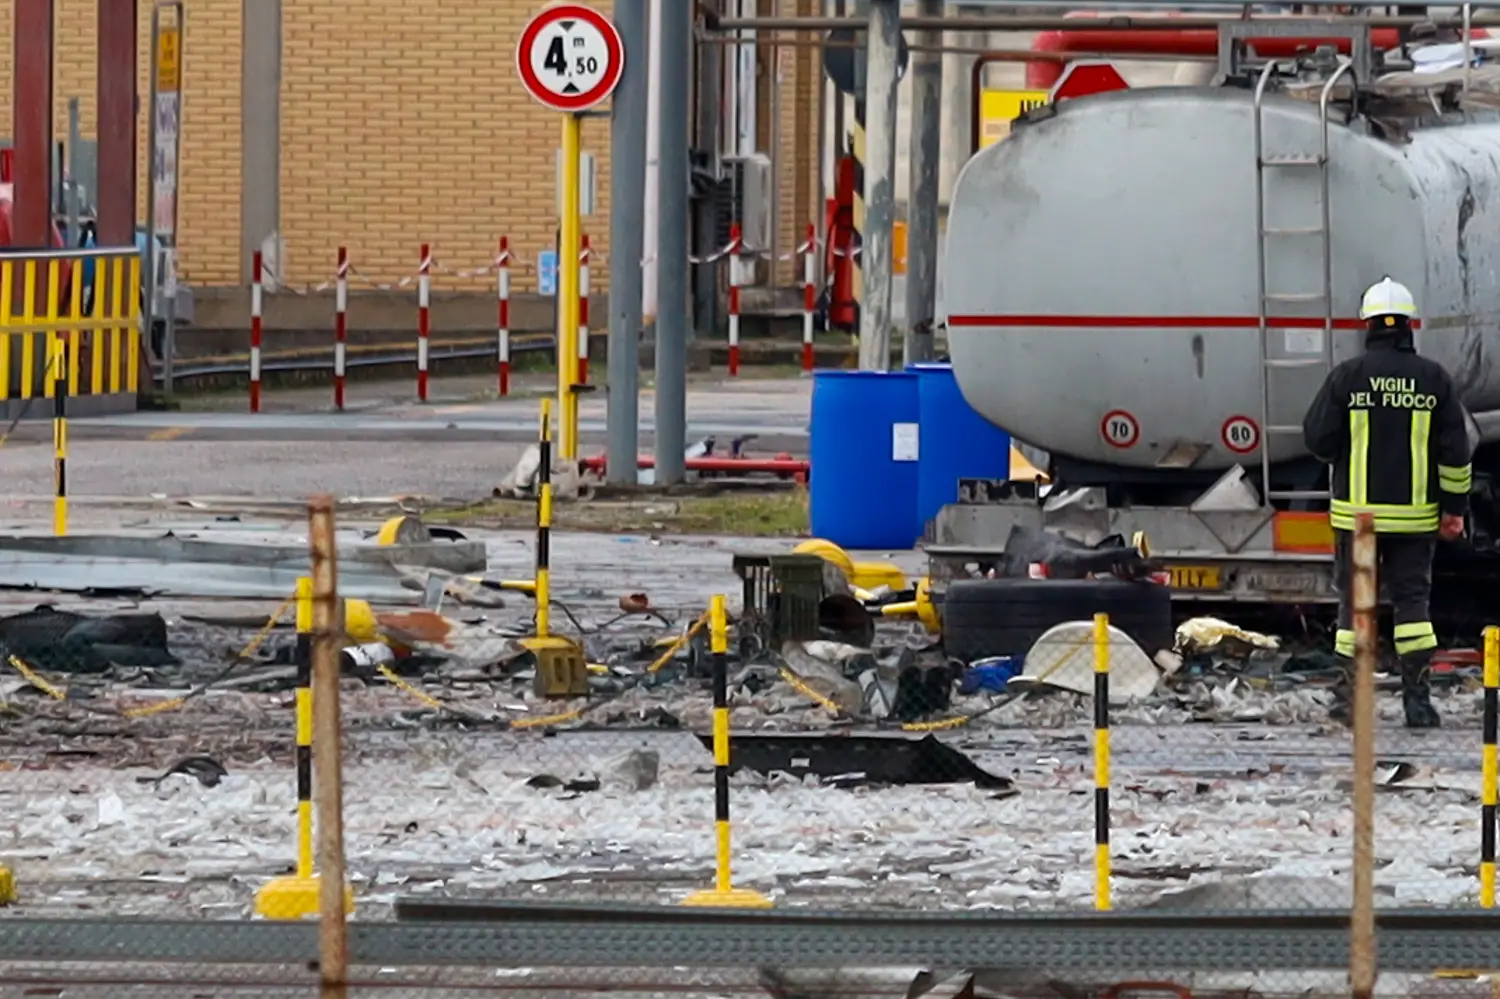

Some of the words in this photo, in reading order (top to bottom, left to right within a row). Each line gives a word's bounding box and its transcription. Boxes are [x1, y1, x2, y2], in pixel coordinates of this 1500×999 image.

[573, 37, 585, 47] m
[1369, 376, 1416, 392] VIGILI
[1382, 393, 1437, 409] FUOCO
[1111, 421, 1129, 438] 70
[1231, 426, 1250, 442] 80
